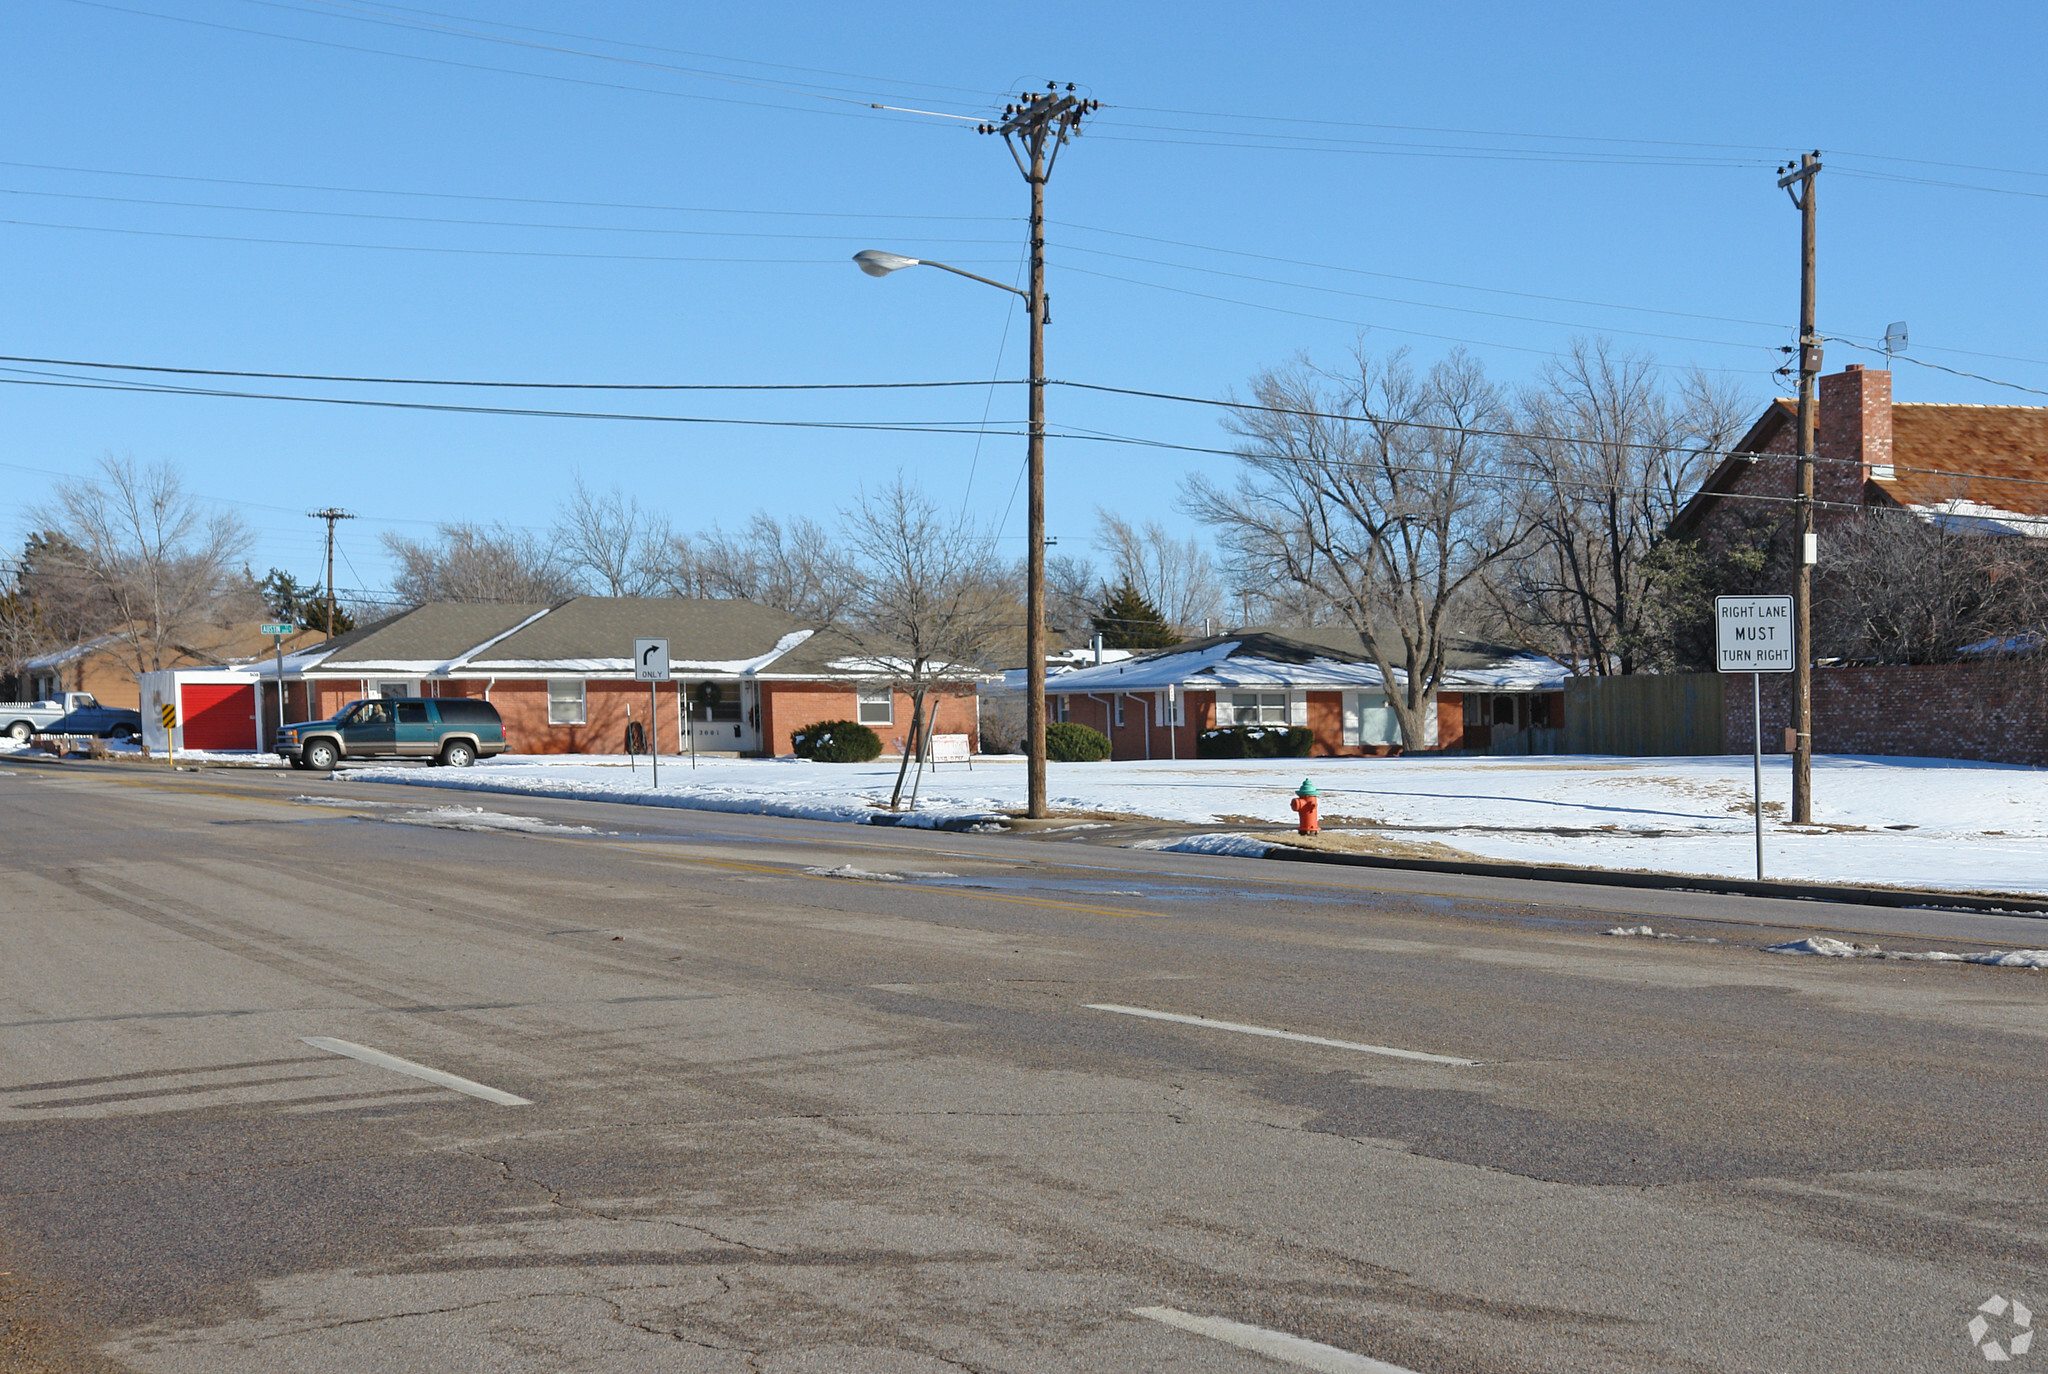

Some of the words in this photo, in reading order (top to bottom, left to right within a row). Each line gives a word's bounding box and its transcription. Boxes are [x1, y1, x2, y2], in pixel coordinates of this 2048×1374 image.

[1722, 606, 1754, 618] RIGHT
[1758, 606, 1787, 617] LANE
[262, 625, 280, 633] AUSTIN
[1735, 626, 1775, 641] MUST
[1722, 650, 1751, 661] TURN
[1756, 649, 1789, 661] RIGHT
